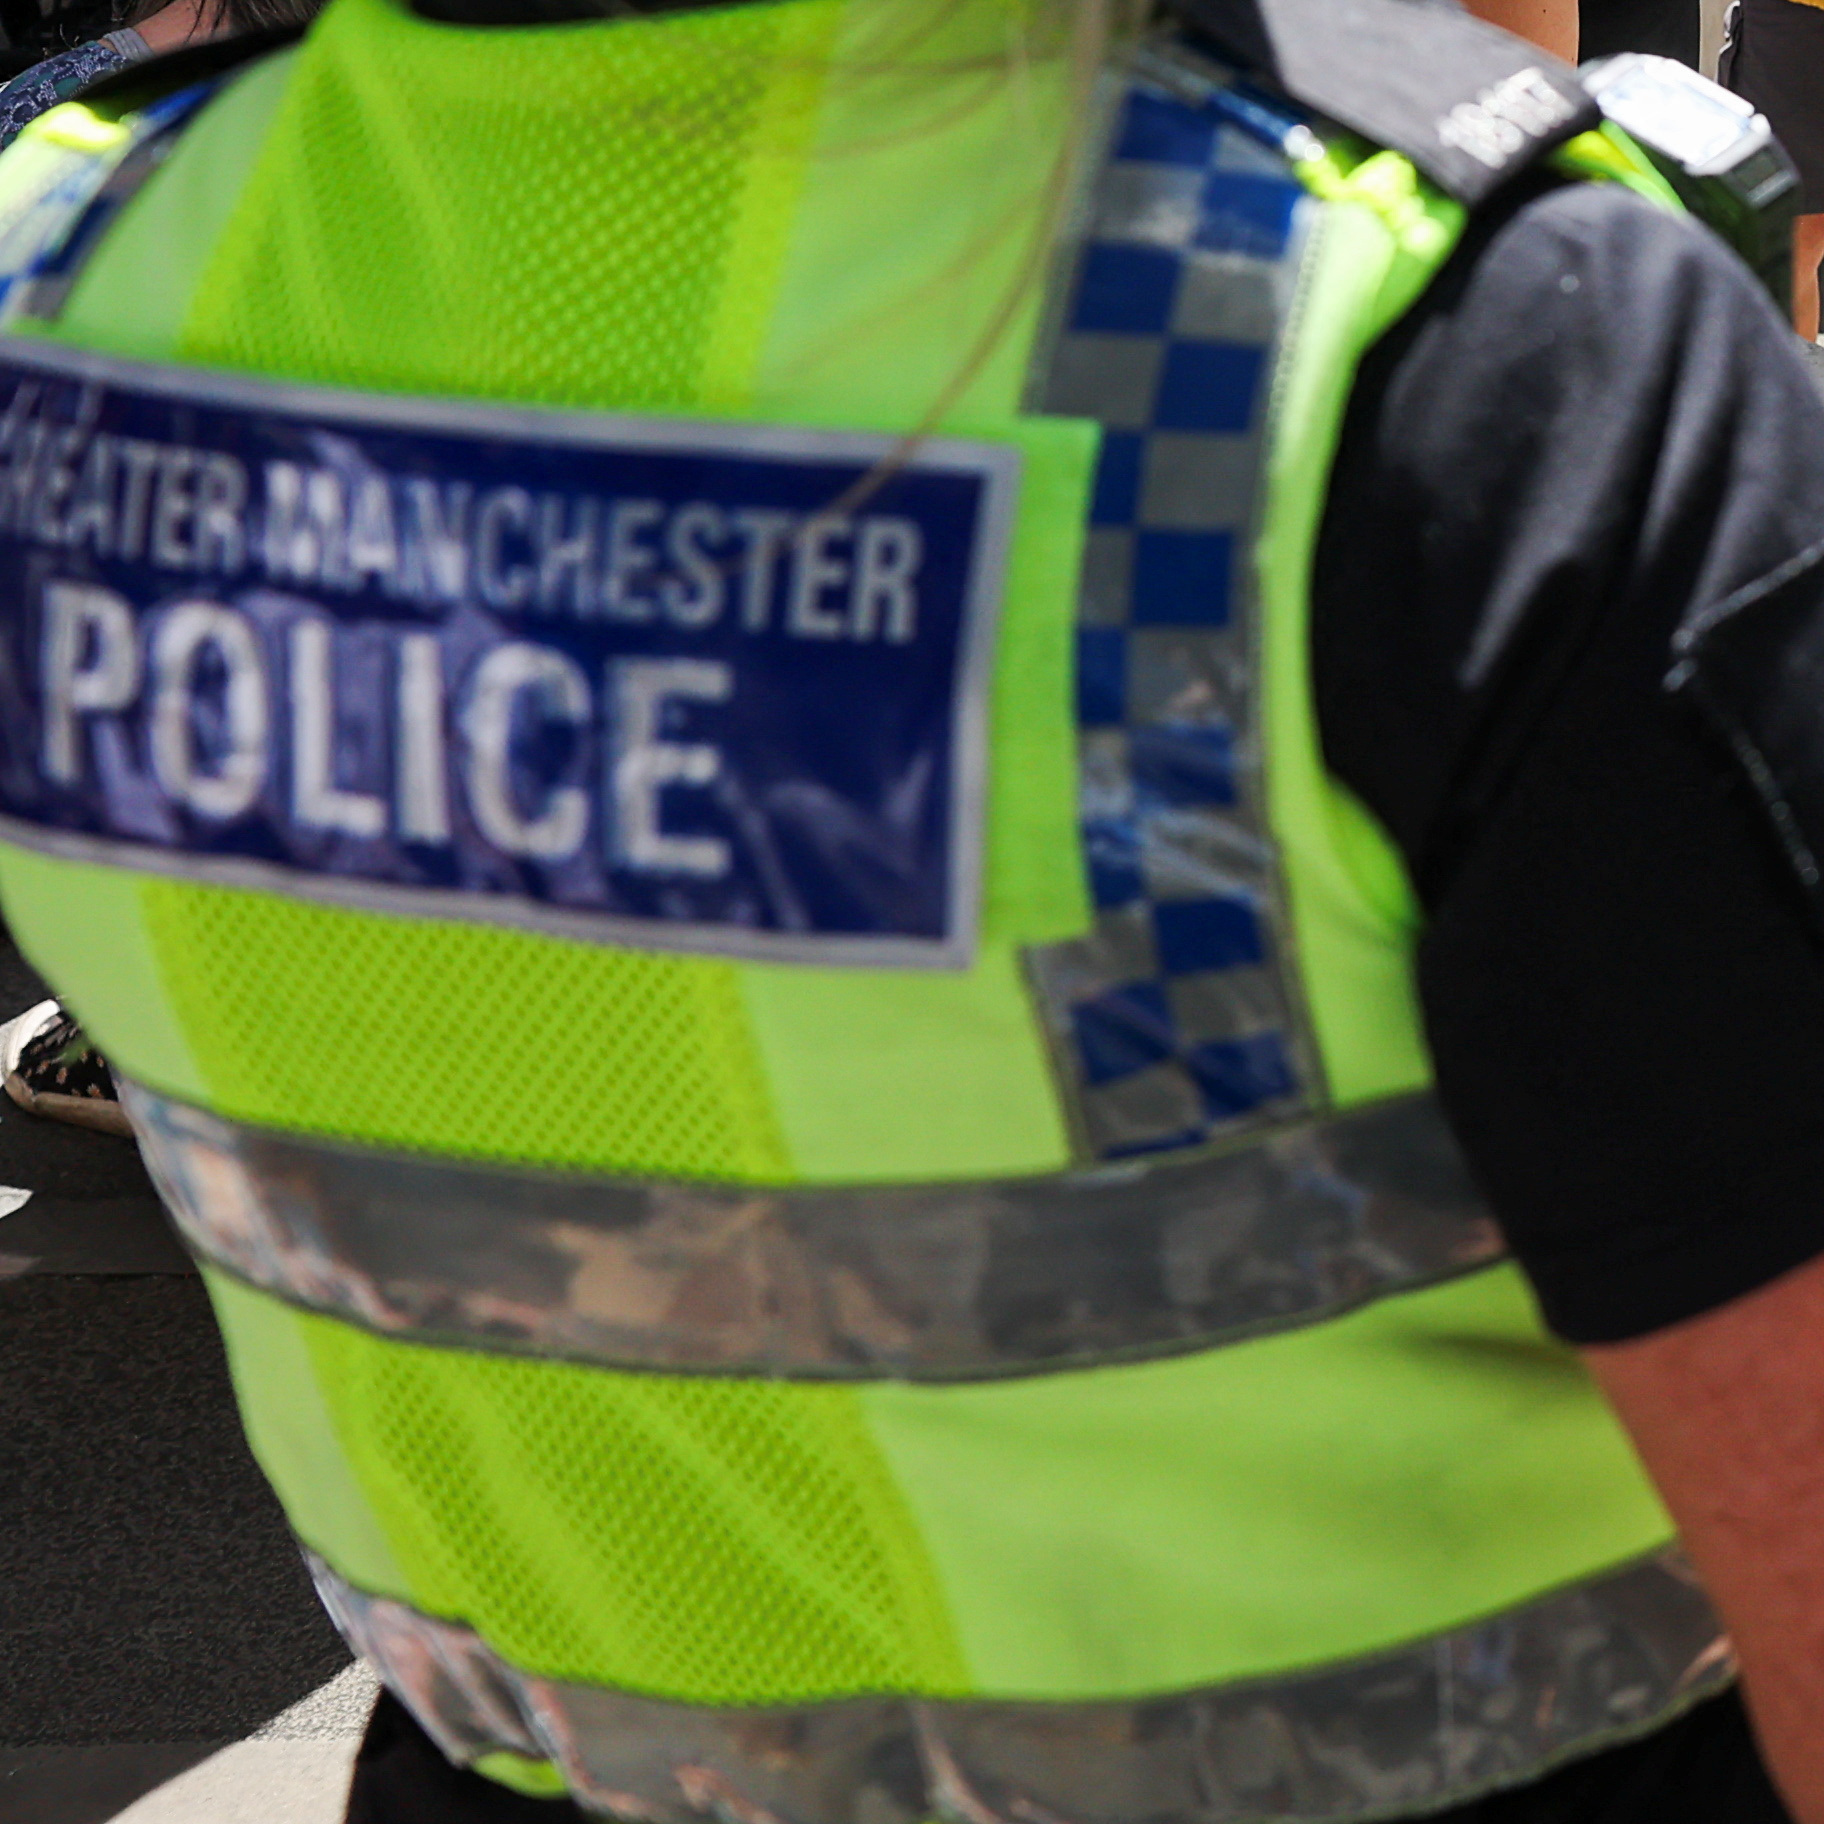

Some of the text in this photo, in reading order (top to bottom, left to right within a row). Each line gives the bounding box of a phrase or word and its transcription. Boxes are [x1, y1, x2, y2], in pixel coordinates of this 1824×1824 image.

[0, 416, 924, 646] REATER MANCHESTER
[38, 581, 737, 878] POLICE
